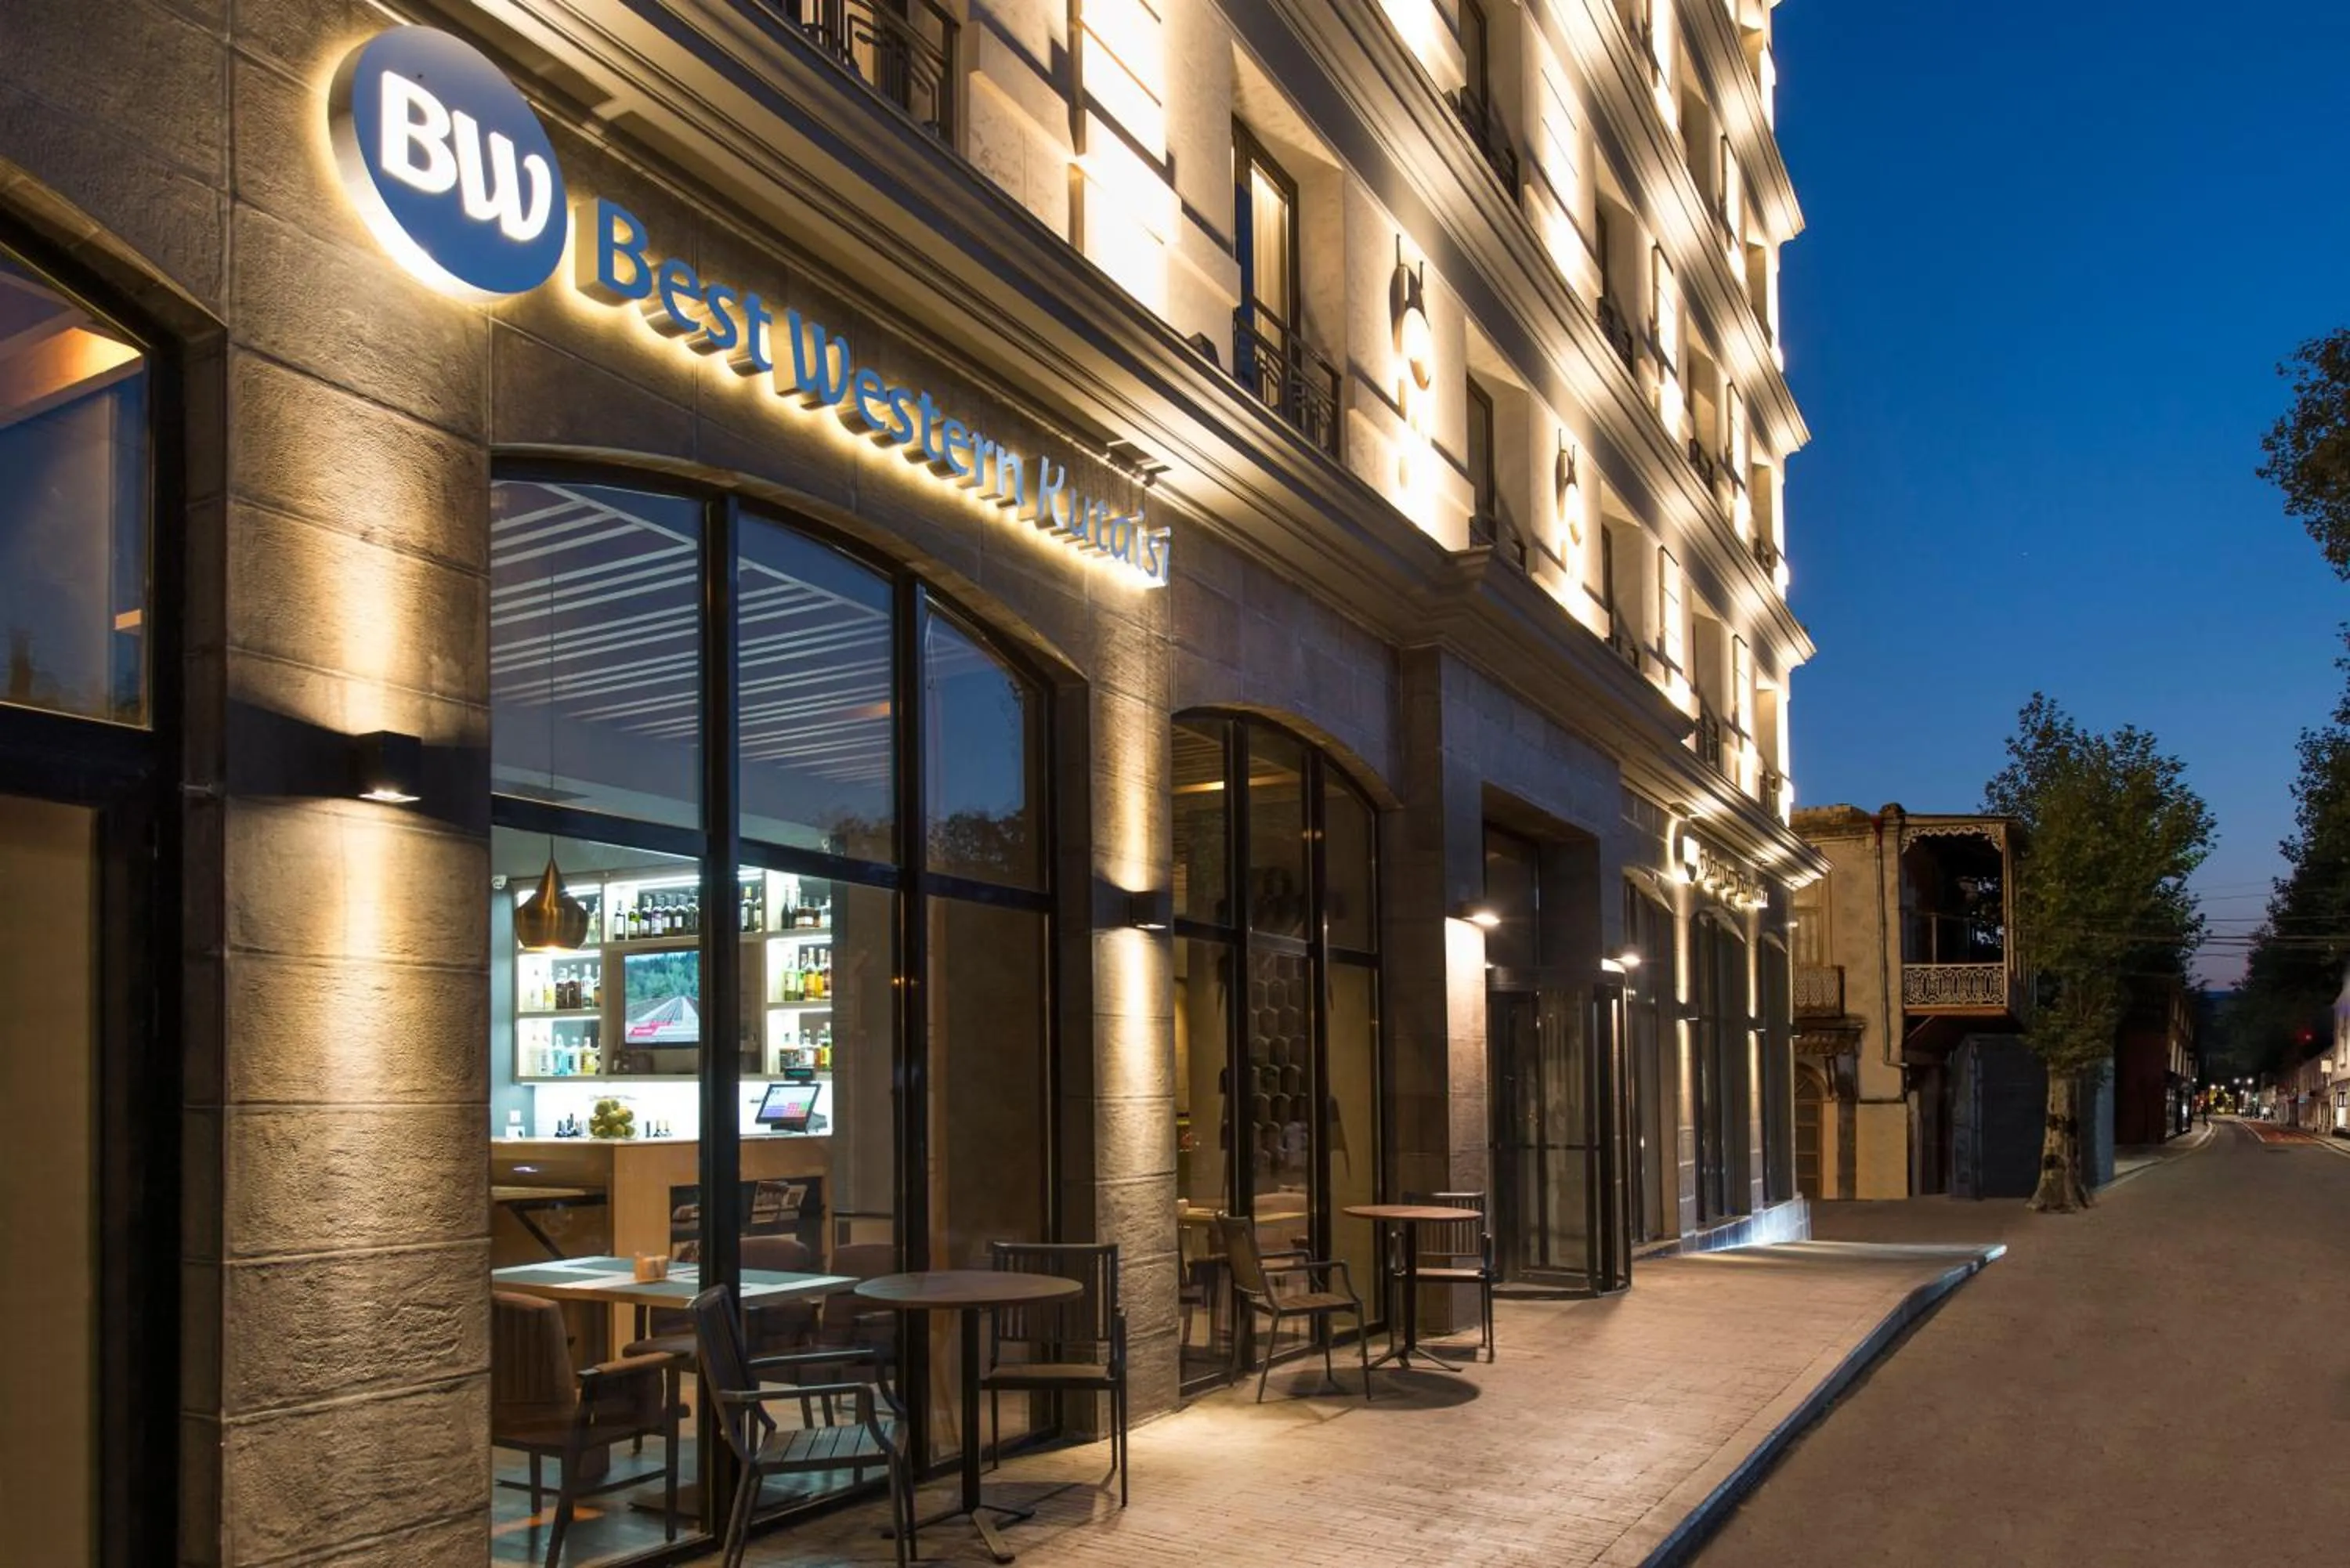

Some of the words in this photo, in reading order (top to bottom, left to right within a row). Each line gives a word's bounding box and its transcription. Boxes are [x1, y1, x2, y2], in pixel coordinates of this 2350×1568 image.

[381, 70, 552, 241] BW
[597, 197, 772, 371] Best
[788, 309, 1025, 508] Western
[1036, 456, 1171, 586] Kutaisi
